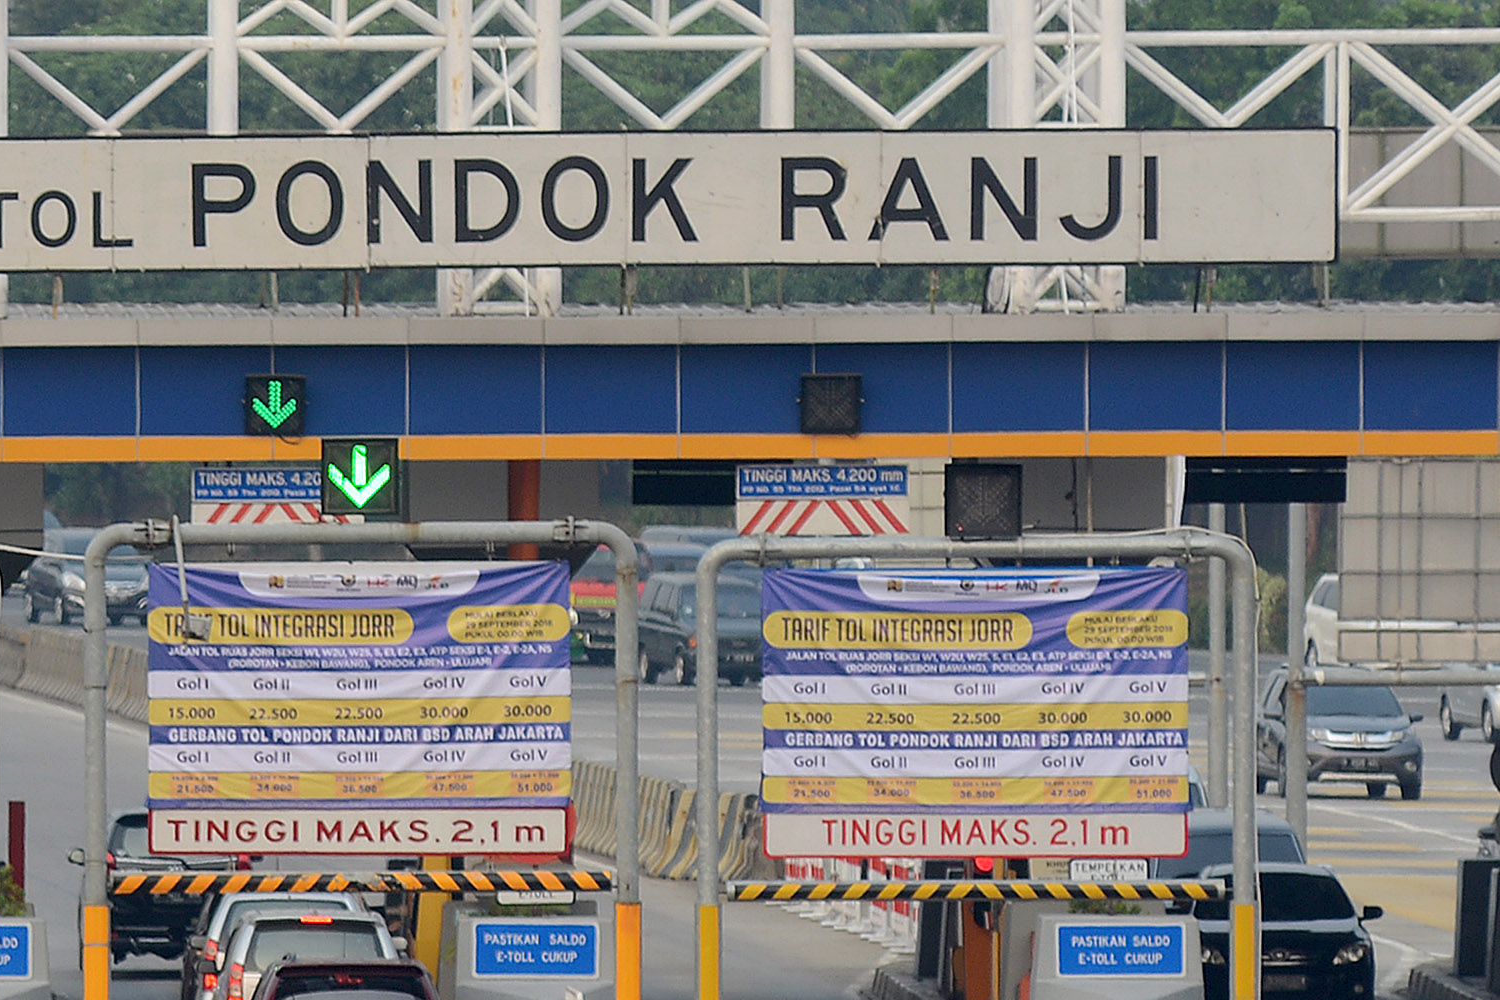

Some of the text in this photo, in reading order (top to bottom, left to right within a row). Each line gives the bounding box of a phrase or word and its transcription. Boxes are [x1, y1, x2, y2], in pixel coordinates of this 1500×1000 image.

[191, 155, 699, 248] PONDOK
[779, 155, 1160, 242] RANJI
[199, 473, 242, 485] TINGGI
[246, 473, 287, 486] MAKS.
[743, 468, 904, 482] TINGGI MAKS. 4.200 mm
[218, 614, 249, 637] TOL
[255, 614, 344, 638] INTEGRASI
[350, 614, 395, 638] JORR
[782, 618, 1014, 643] TARIF TOL INTEGRASI JORR
[785, 711, 833, 724] 15.000
[866, 712, 915, 725] 22.500
[952, 712, 1000, 725] 22.500
[1038, 711, 1088, 724] 30.000
[1123, 710, 1172, 723] 30.000
[168, 726, 564, 743] GERBANG TOL PONDOK RANJI DARI BSD ARAH JAKARTA
[785, 732, 1184, 748] GERBANG TOL PONDOK RANJI DARI BSD ARAH JAKARTA
[167, 819, 546, 847] TINGGI MAKS. 2,1 m
[822, 819, 927, 846] TINGGI
[940, 819, 1037, 846] MAKS.
[1100, 825, 1129, 846] m
[483, 933, 587, 946] PASTIKAN SALDO
[1071, 935, 1171, 948] PASTIKAN SALDO
[496, 951, 578, 963] E-TOLL CUKUP
[1078, 953, 1163, 965] E-TOLL CUKUP
